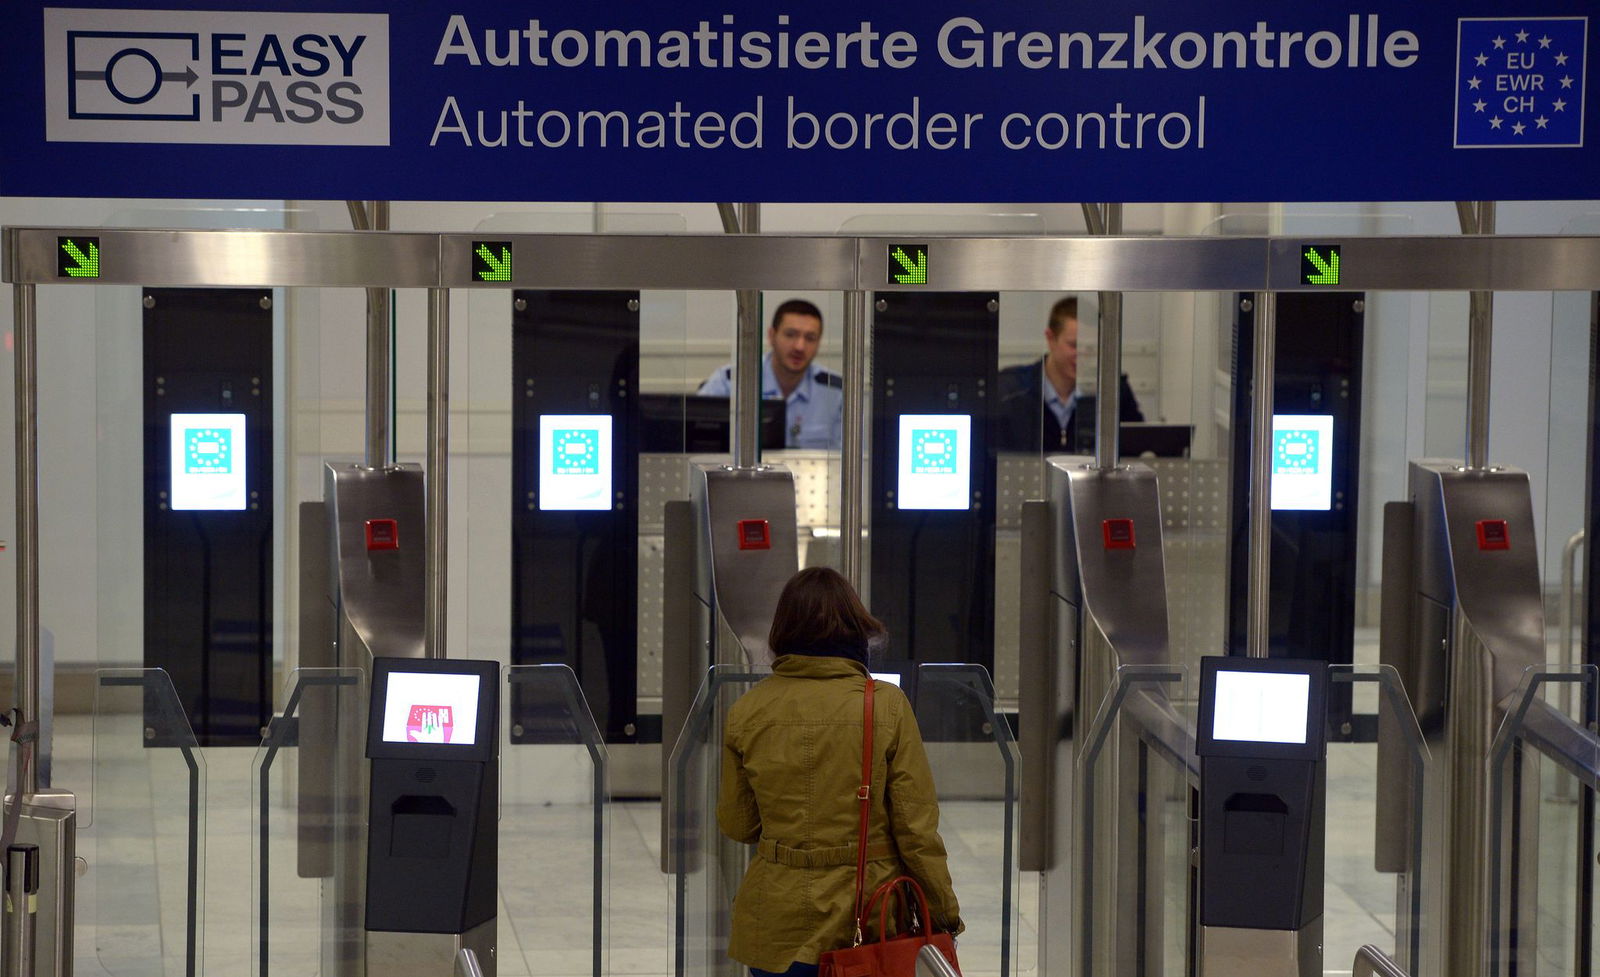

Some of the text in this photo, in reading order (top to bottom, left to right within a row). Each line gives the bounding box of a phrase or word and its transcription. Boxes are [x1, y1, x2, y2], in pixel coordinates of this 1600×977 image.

[211, 32, 367, 77] EASY
[434, 14, 1419, 69] Automatisierte Grenzkontrolle
[1507, 53, 1534, 69] EU
[211, 80, 364, 124] PASS
[1496, 75, 1543, 91] EWR
[1504, 96, 1534, 112] CH
[430, 96, 1206, 149] Automated border control
